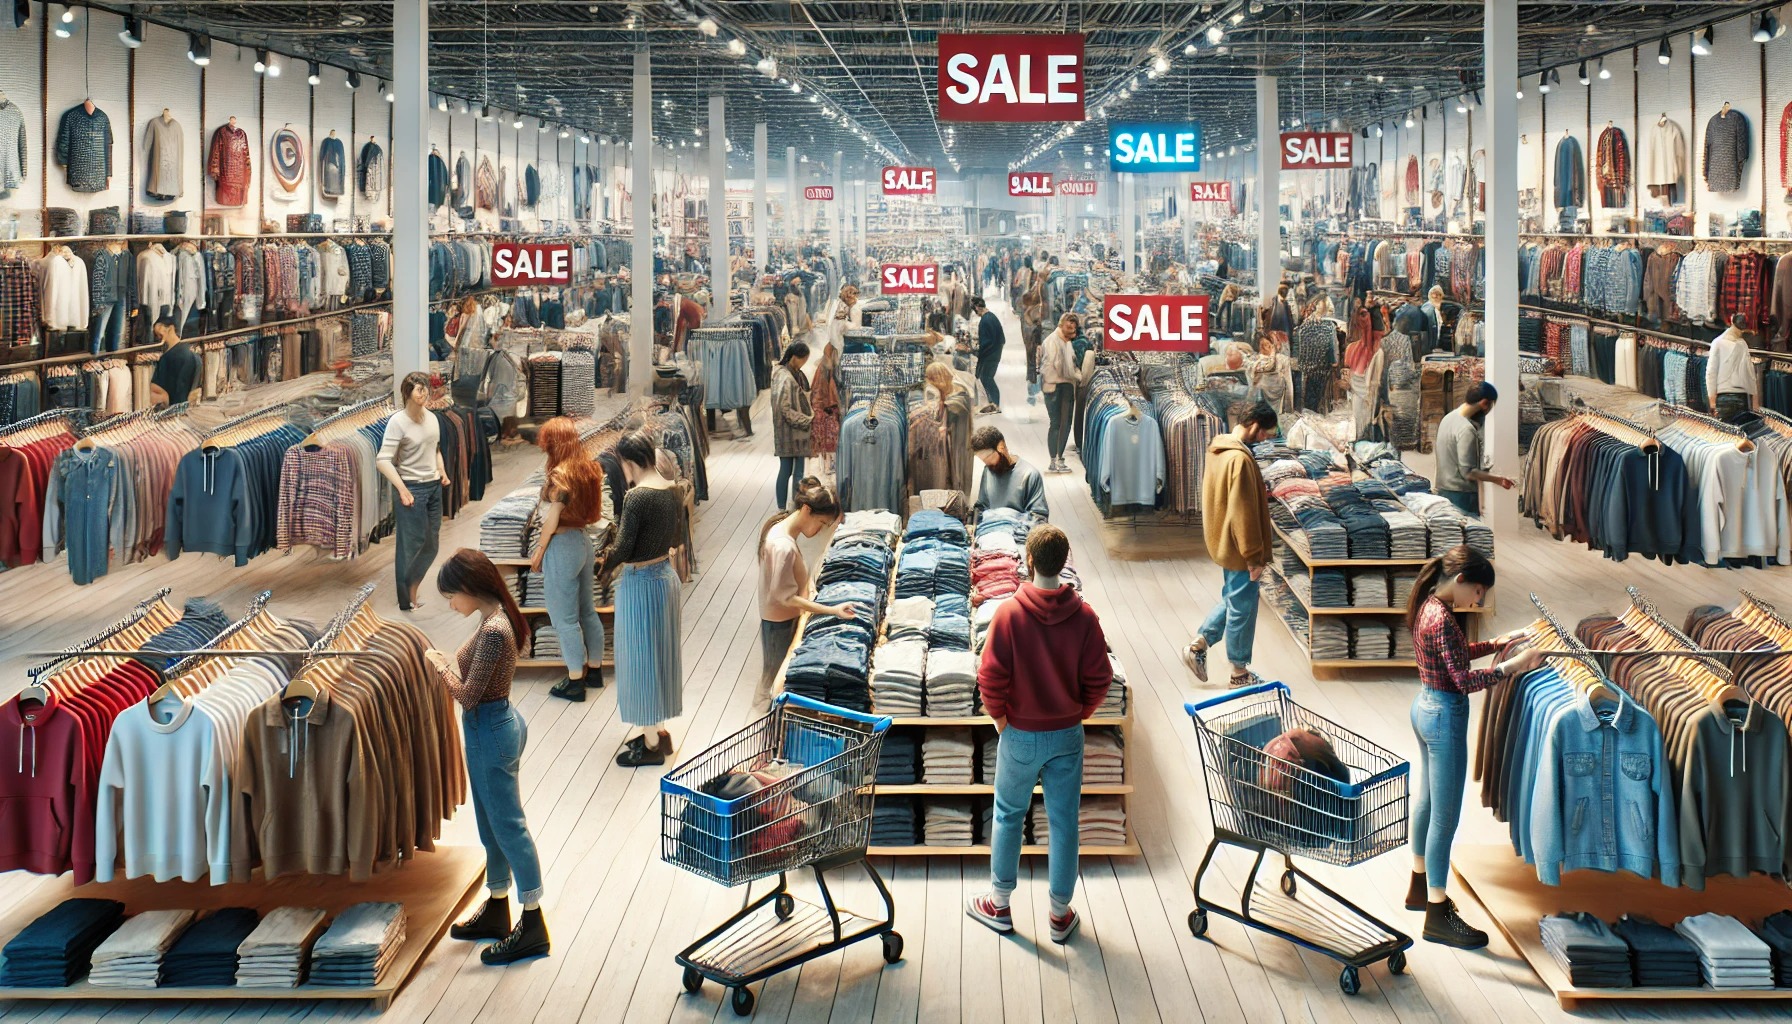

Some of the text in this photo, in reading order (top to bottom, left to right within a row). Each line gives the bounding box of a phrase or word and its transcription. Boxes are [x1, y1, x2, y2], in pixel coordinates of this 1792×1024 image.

[945, 53, 1078, 105] SALE
[1115, 132, 1195, 164] SALE
[1286, 137, 1350, 165] SALE
[884, 169, 934, 190] SALE
[494, 249, 569, 279] SALE
[884, 267, 935, 289] SALE
[1109, 304, 1203, 341] SALE
